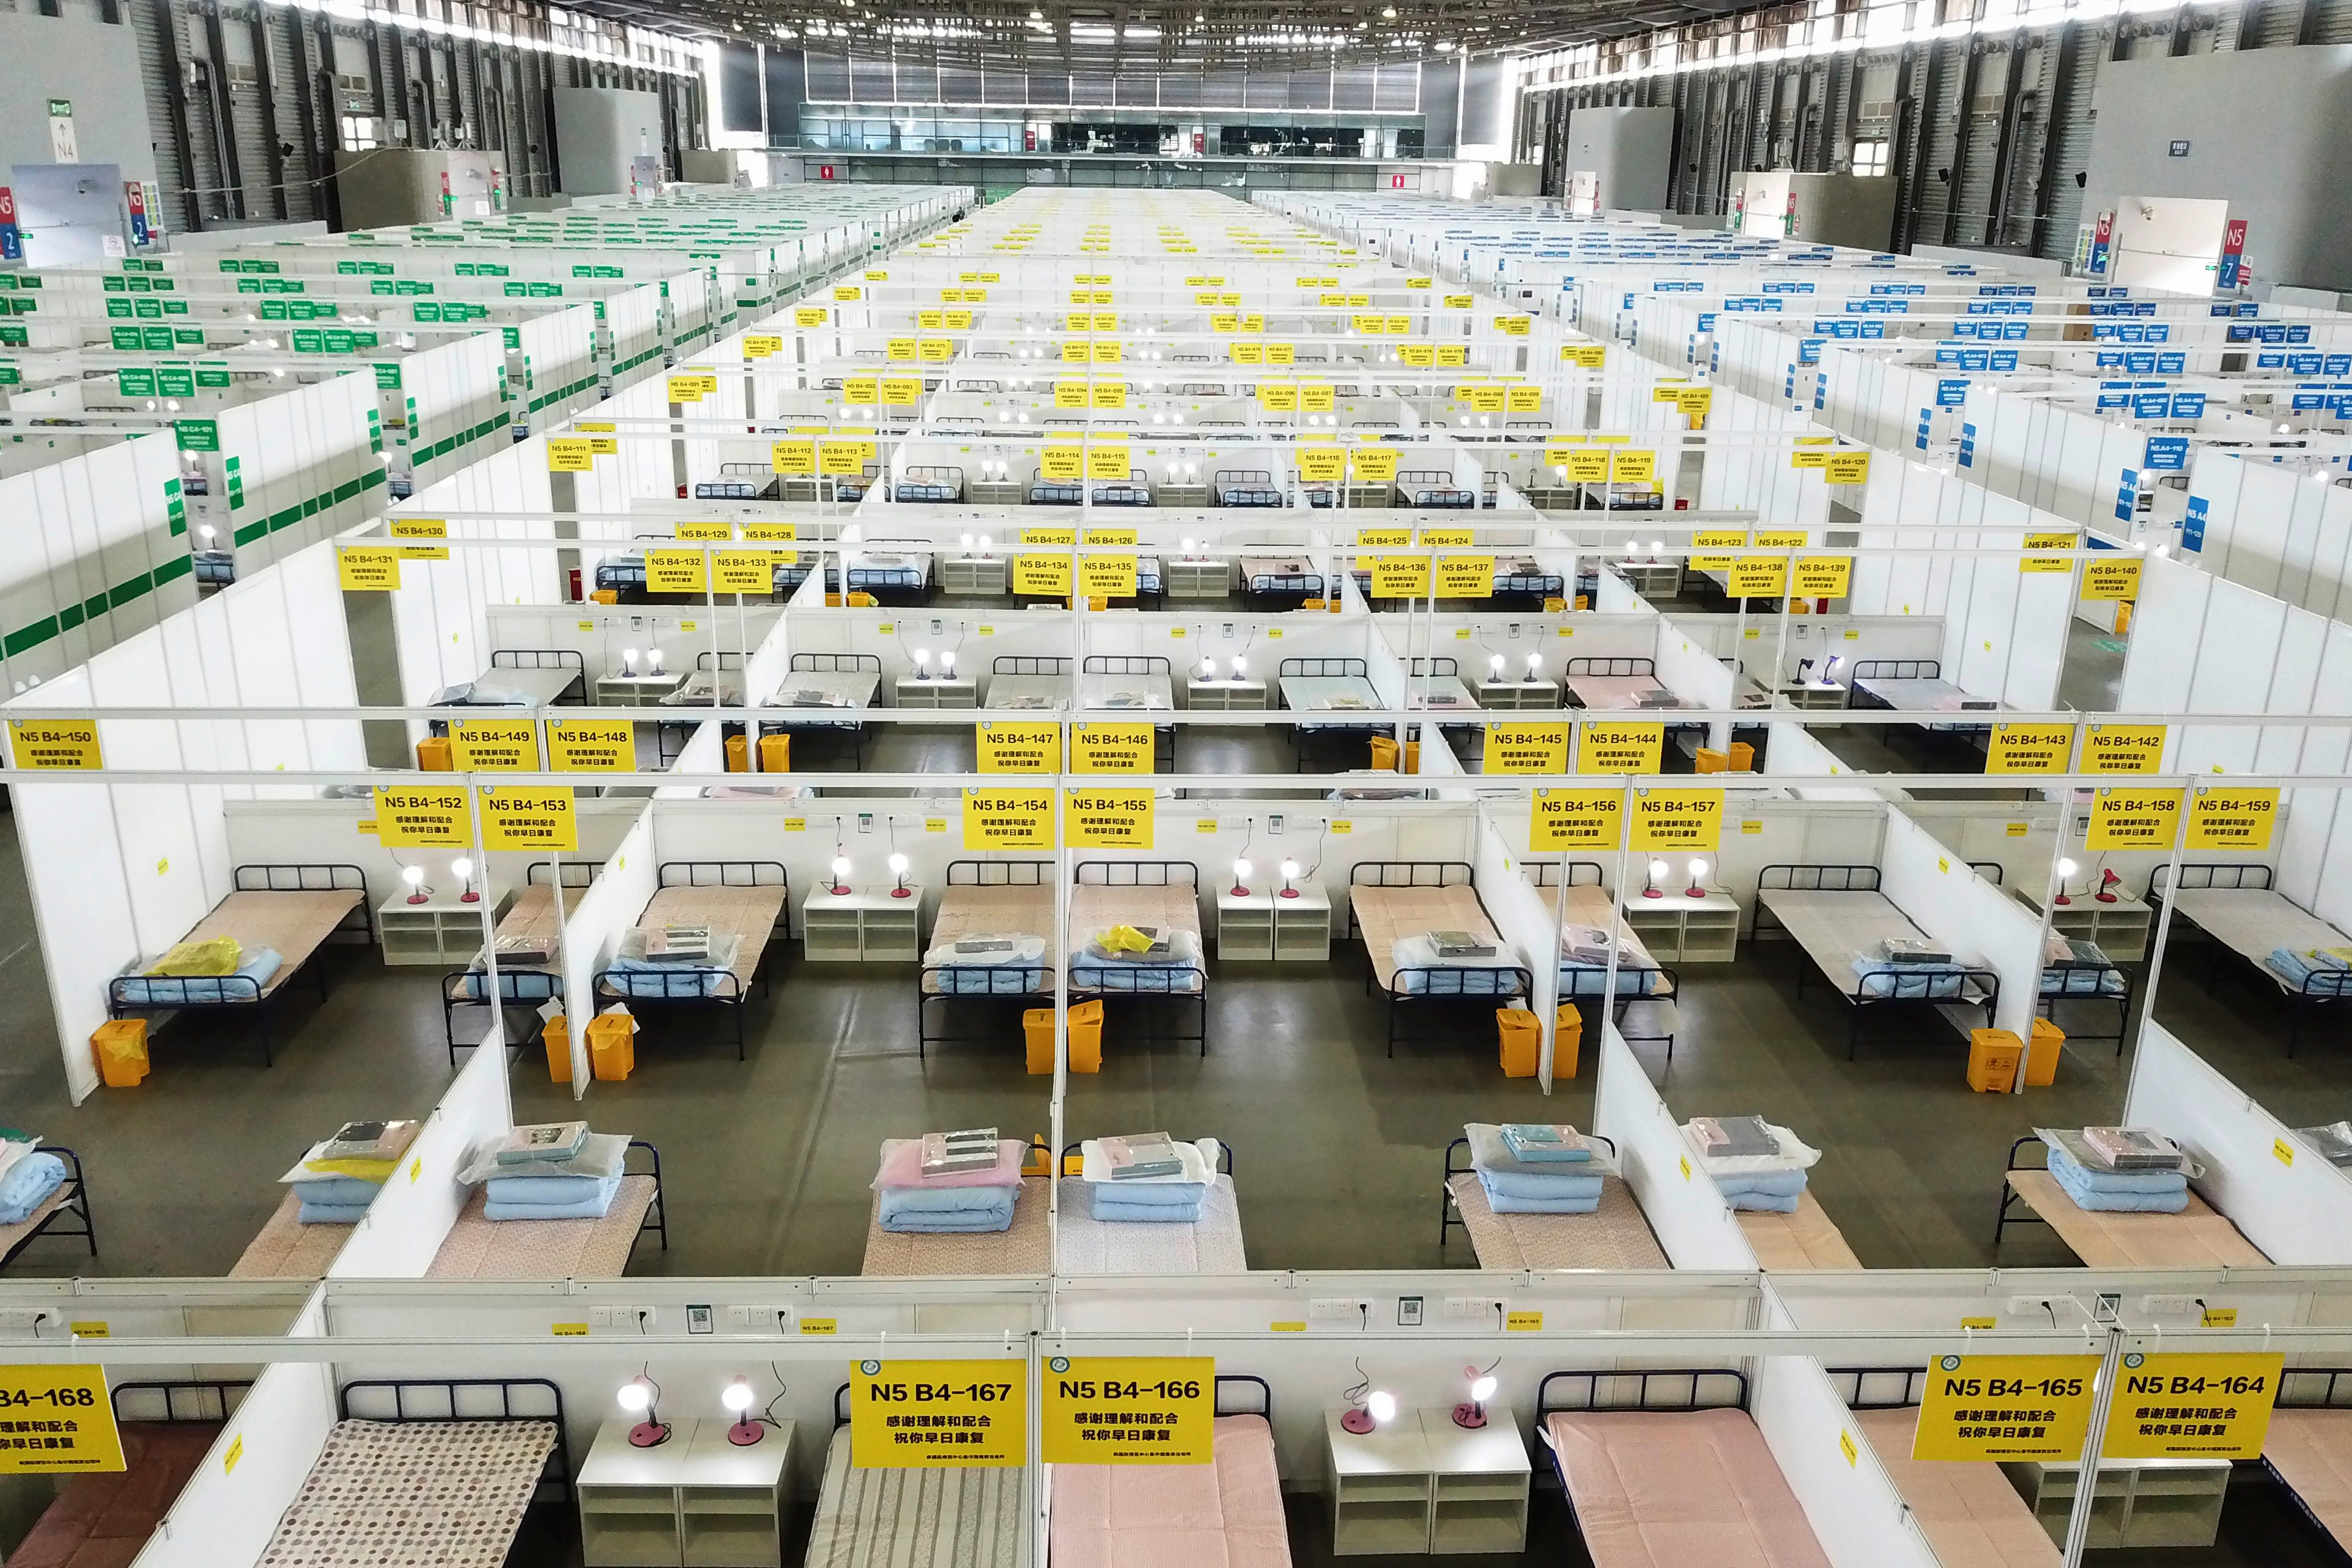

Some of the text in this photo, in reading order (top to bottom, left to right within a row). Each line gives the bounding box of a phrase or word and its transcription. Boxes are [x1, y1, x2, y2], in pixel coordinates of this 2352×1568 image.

[58, 142, 73, 158] N4
[137, 221, 144, 237] 2
[2097, 220, 2109, 236] N5
[6, 232, 15, 250] 2
[2227, 228, 2244, 246] N5
[2224, 262, 2234, 279] 7
[2187, 508, 2197, 519] N5
[1035, 561, 1067, 569] B4-134
[20, 731, 91, 742] N5 B4-150
[460, 731, 529, 742] N5 B4-149
[558, 731, 627, 742] N5 B4-148
[987, 733, 1053, 744] N5 B4-147
[1082, 734, 1148, 745] N5 B4-146
[1495, 734, 1562, 744] N5 B4-145
[1590, 734, 1657, 744] N5 B4-144
[2000, 735, 2066, 745] N5 B4-143
[2093, 736, 2159, 747] N5 B4-142
[385, 797, 462, 808] N5 B4-152
[489, 799, 566, 811] N5 B4-153
[973, 800, 1048, 811] N5 B4-154
[1073, 799, 1147, 811] N5 B4-155
[1542, 800, 1616, 812] N5 B4-156
[1641, 801, 1715, 812] N5 B4-157
[2102, 800, 2175, 811] N5 B4-158
[2198, 800, 2270, 811] N5 B4-159
[1080, 817, 1135, 826] 感谢理解和配合
[1548, 819, 1604, 827] 感谢理解和配合
[1060, 1381, 1200, 1399] N5 B4-166
[1945, 1379, 2083, 1397] N5 B4-165
[2127, 1376, 2265, 1394] N5 B4-164
[871, 1383, 1012, 1401] N5 B4-167
[1074, 1412, 1178, 1425] 感谢理解和配合
[1953, 1410, 2056, 1422] 感谢理解和配合
[2135, 1407, 2237, 1419] 感谢理解和配合
[886, 1415, 991, 1427] 感谢理解和配合
[1081, 1429, 1171, 1441] 祝你早日康复
[1958, 1426, 2046, 1438] 祝你早日康复
[2139, 1424, 2227, 1436] 祝你早日康复
[894, 1432, 984, 1444] 祝你早日康复
